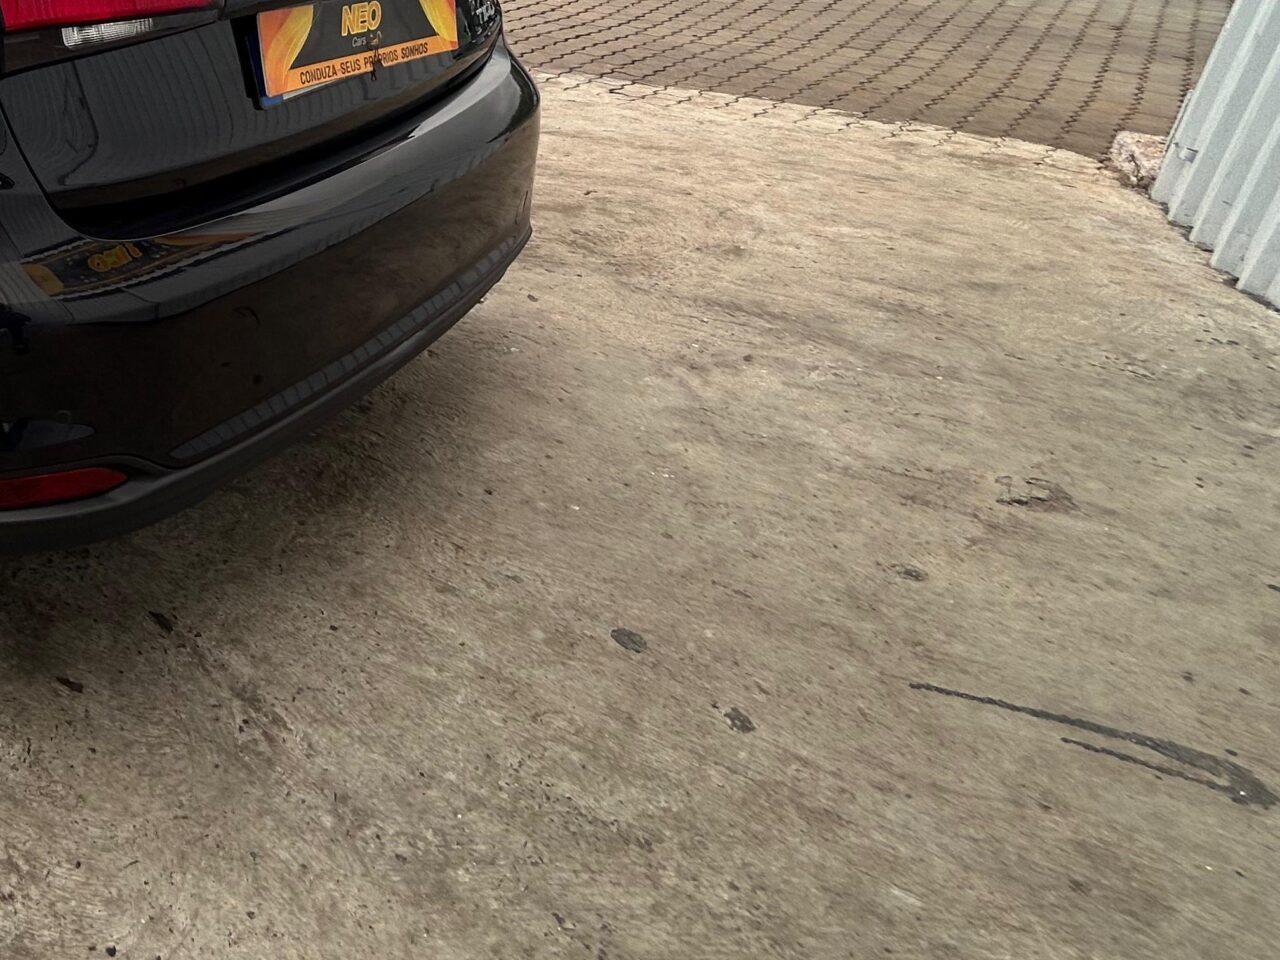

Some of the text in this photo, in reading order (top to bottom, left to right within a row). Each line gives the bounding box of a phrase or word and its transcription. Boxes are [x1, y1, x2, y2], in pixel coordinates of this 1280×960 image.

[341, 0, 382, 37] NEO
[300, 65, 338, 85] CONDUZA
[340, 58, 362, 75] SEUS
[400, 42, 429, 60] SONHOS
